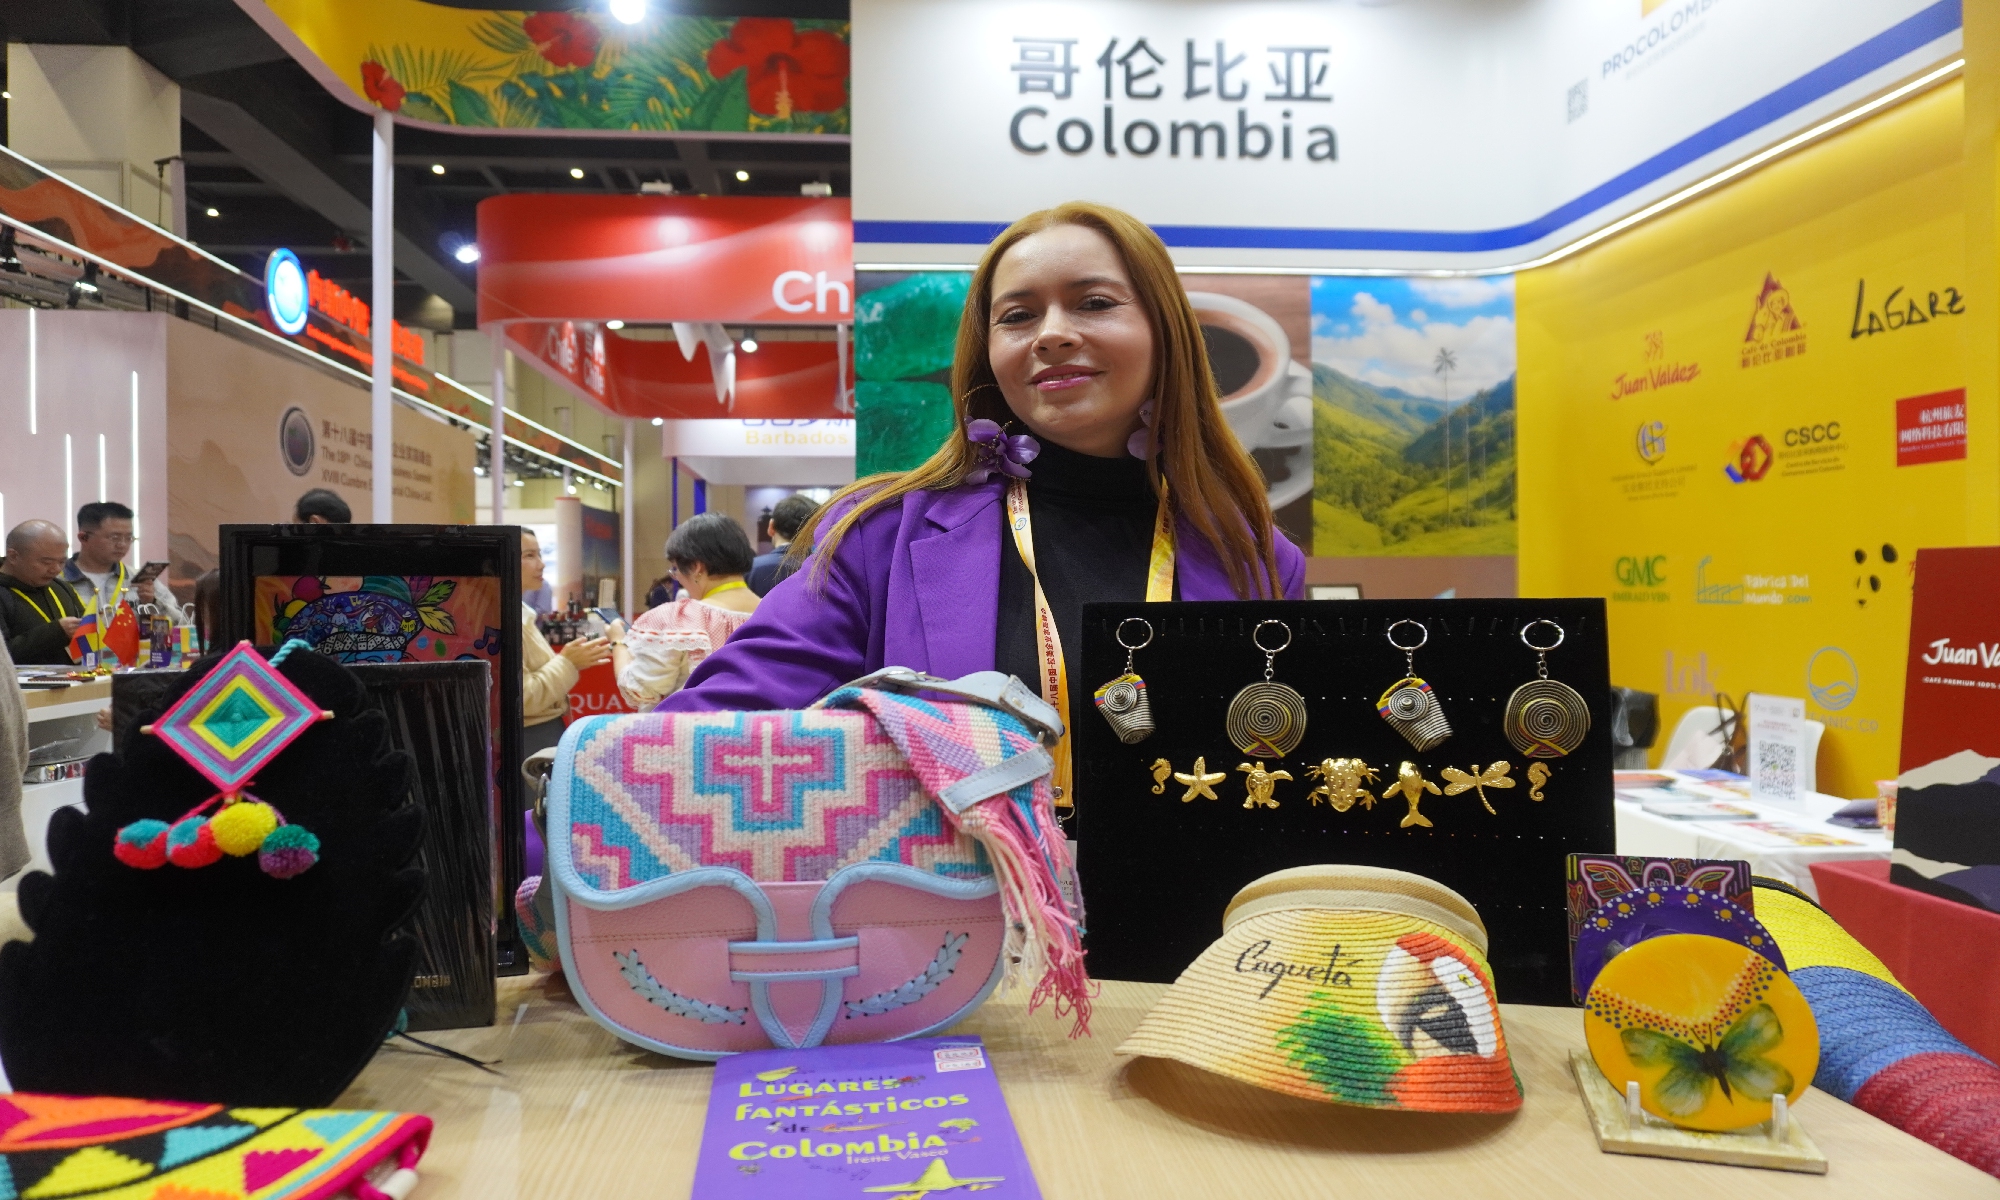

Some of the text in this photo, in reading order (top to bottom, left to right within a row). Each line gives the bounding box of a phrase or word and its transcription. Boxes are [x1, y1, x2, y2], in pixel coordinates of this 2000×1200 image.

[1602, 0, 1718, 79] PROCOLOMB
[1010, 36, 1333, 102] 哥伦比亚
[1009, 105, 1339, 162] Colombia
[1612, 362, 1701, 400] Juan Valdez
[745, 429, 848, 445] Barbados
[1785, 421, 1841, 447] CSCC
[1900, 421, 1967, 444] 网络科技有限
[1615, 555, 1667, 586] GMC
[1792, 574, 1809, 588] Del
[1922, 638, 1977, 665] Juan
[1944, 677, 1975, 687] PREMIUM
[1234, 940, 1364, 1000] Caquetá
[847, 1147, 948, 1165] Irene Vasco
